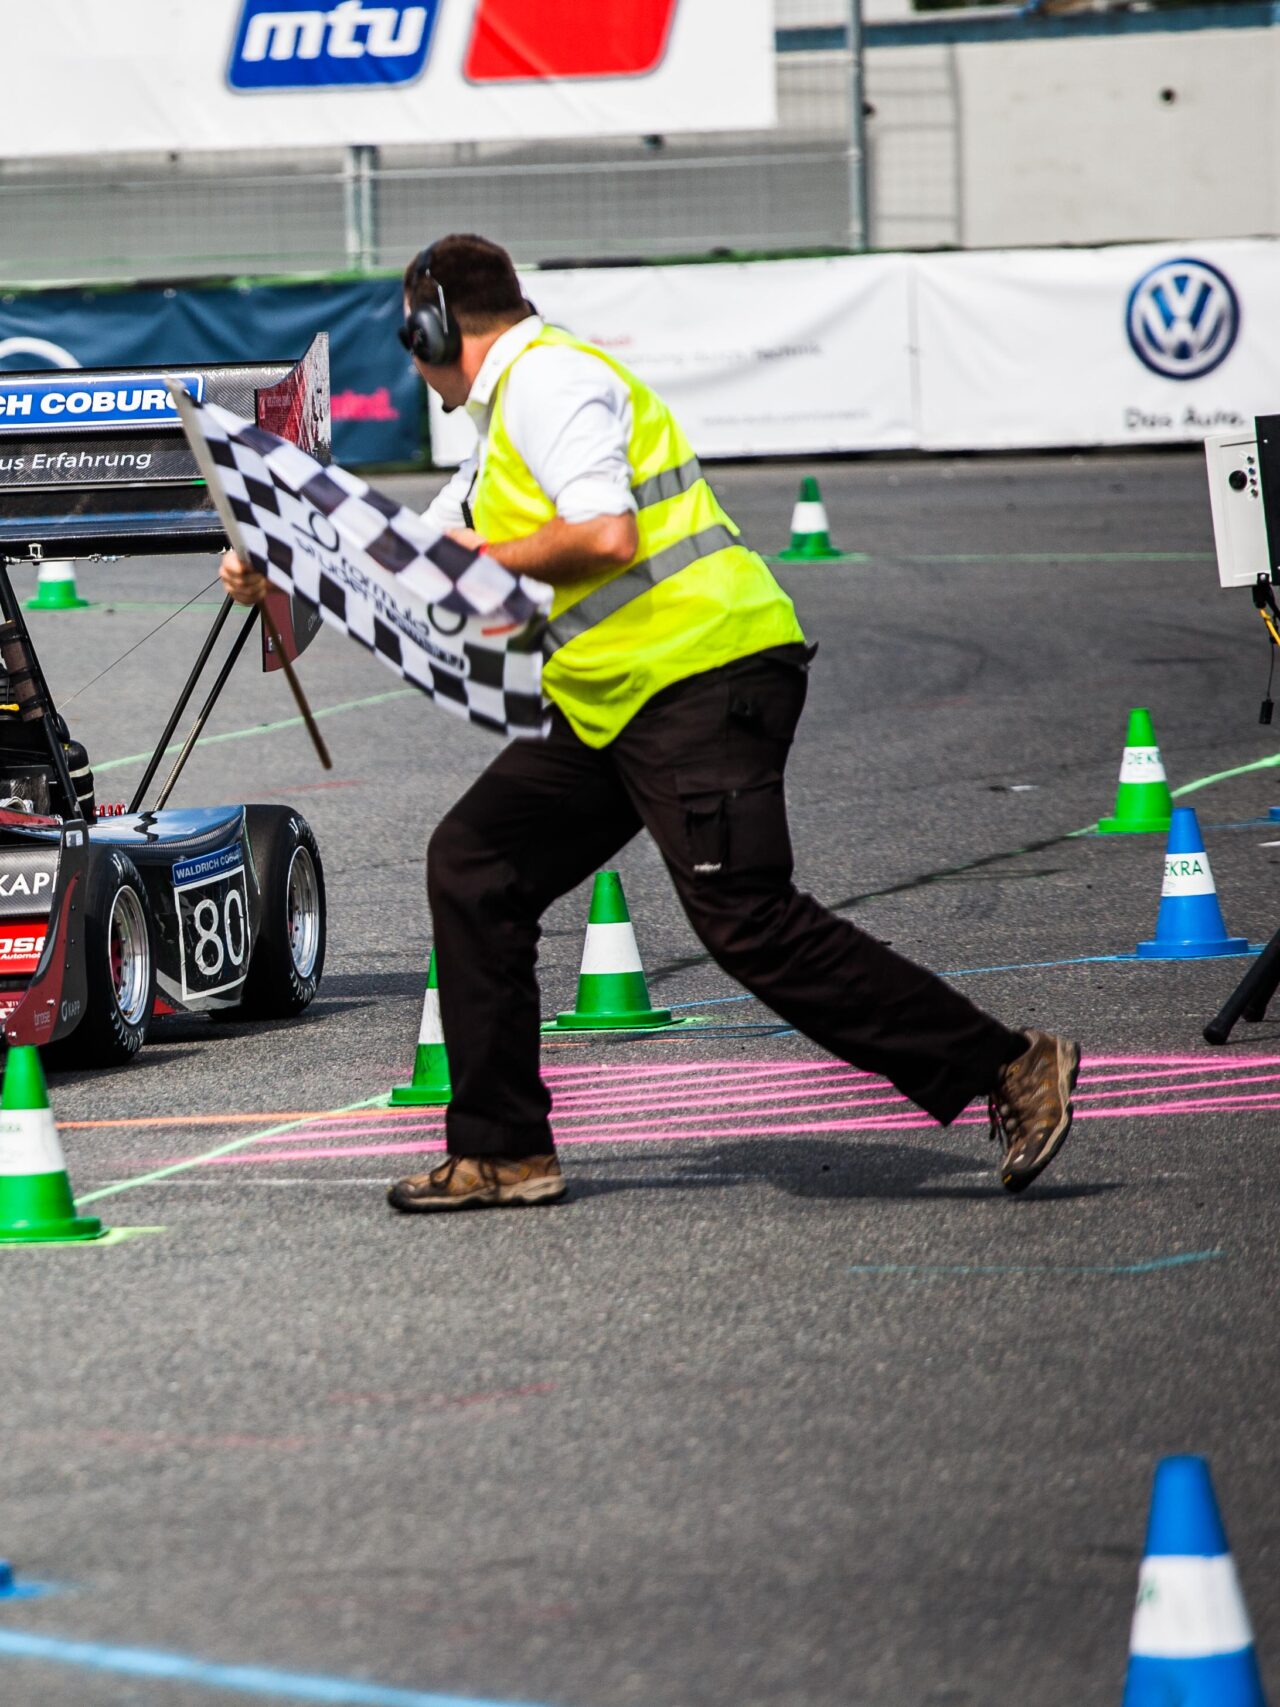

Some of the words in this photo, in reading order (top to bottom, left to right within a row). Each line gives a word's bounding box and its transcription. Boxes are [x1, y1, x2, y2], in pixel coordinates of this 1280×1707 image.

[241, 0, 428, 61] mtu
[32, 452, 152, 471] Erfahrung
[176, 858, 220, 880] WALDRICH
[193, 889, 245, 976] 80
